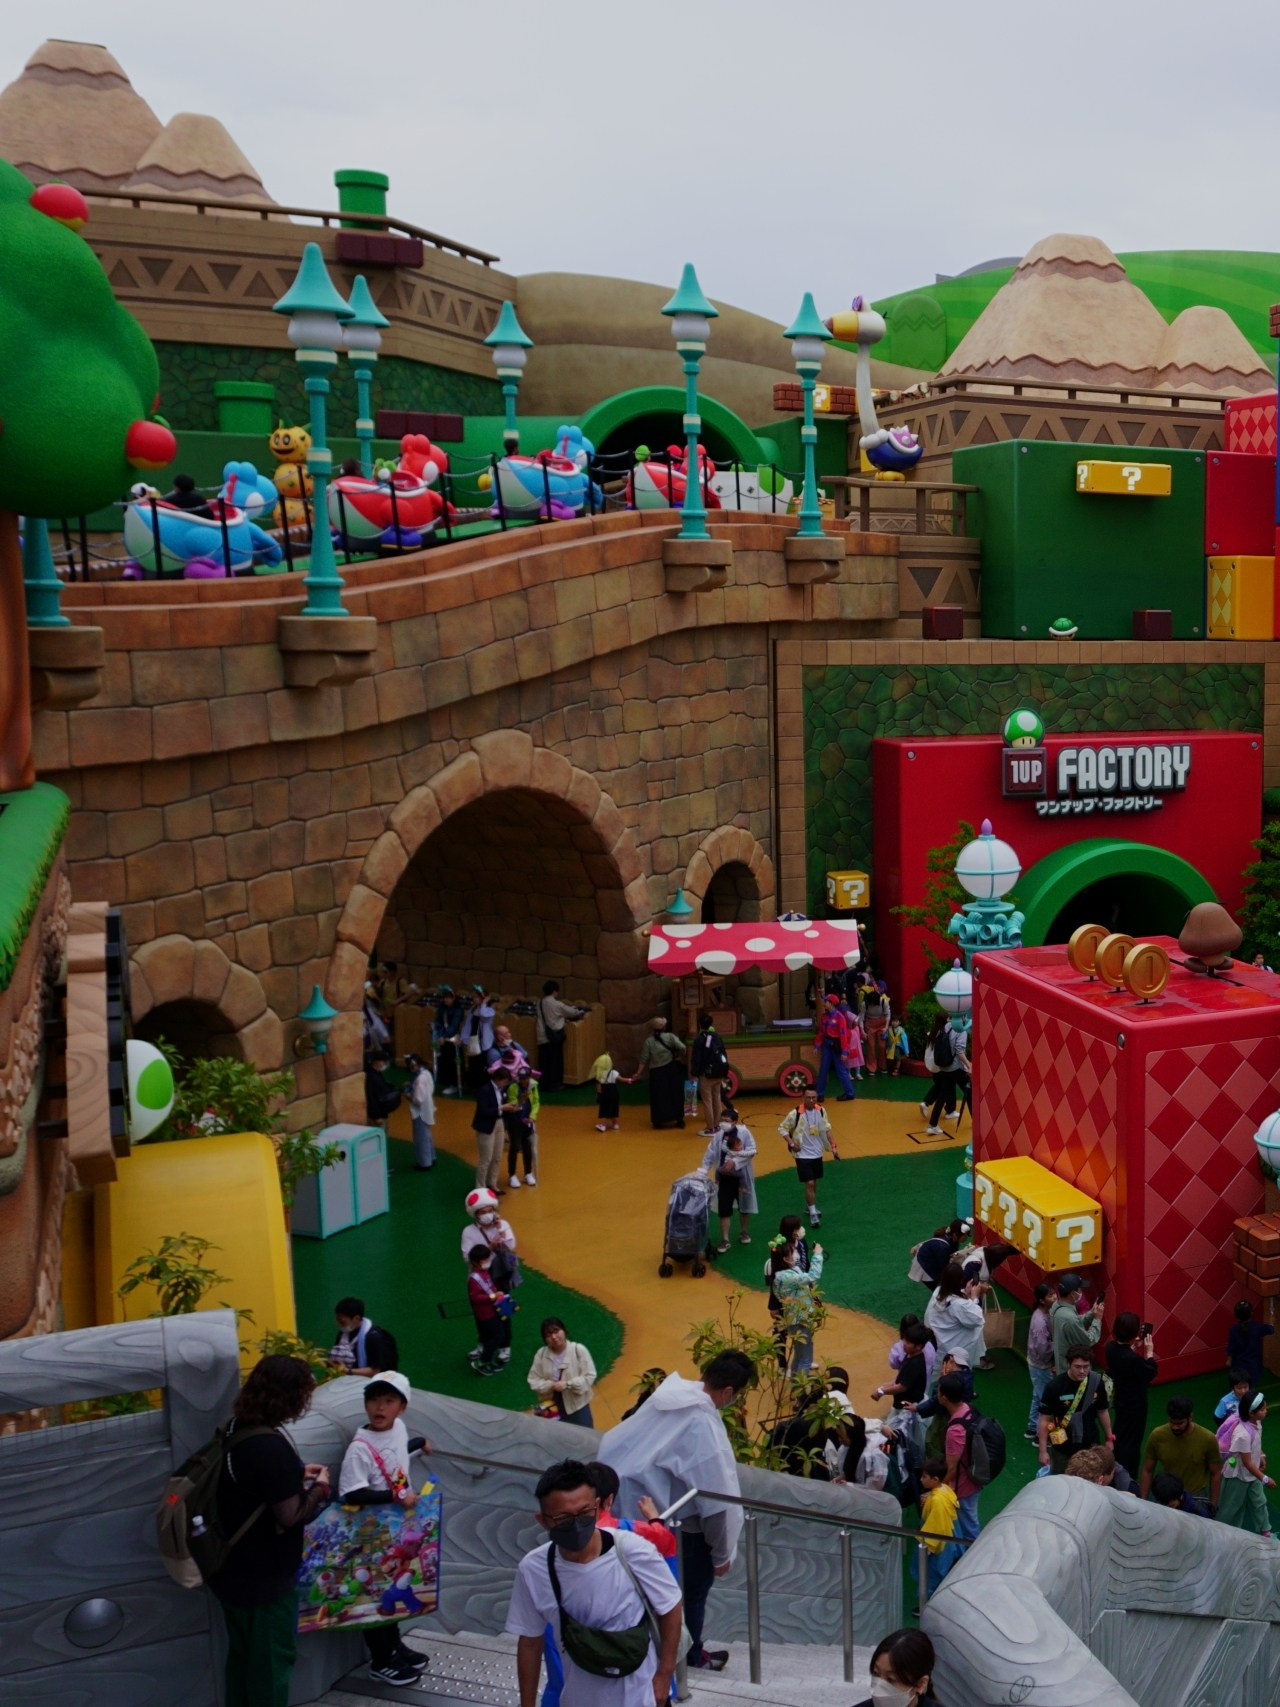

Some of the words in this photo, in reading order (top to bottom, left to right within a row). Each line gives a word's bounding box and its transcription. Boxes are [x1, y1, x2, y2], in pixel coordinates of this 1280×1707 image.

[1010, 760, 1042, 784] 1UP
[1057, 745, 1191, 792] FACTORY
[1036, 796, 1163, 815] ワンナップ・ファクトリー
